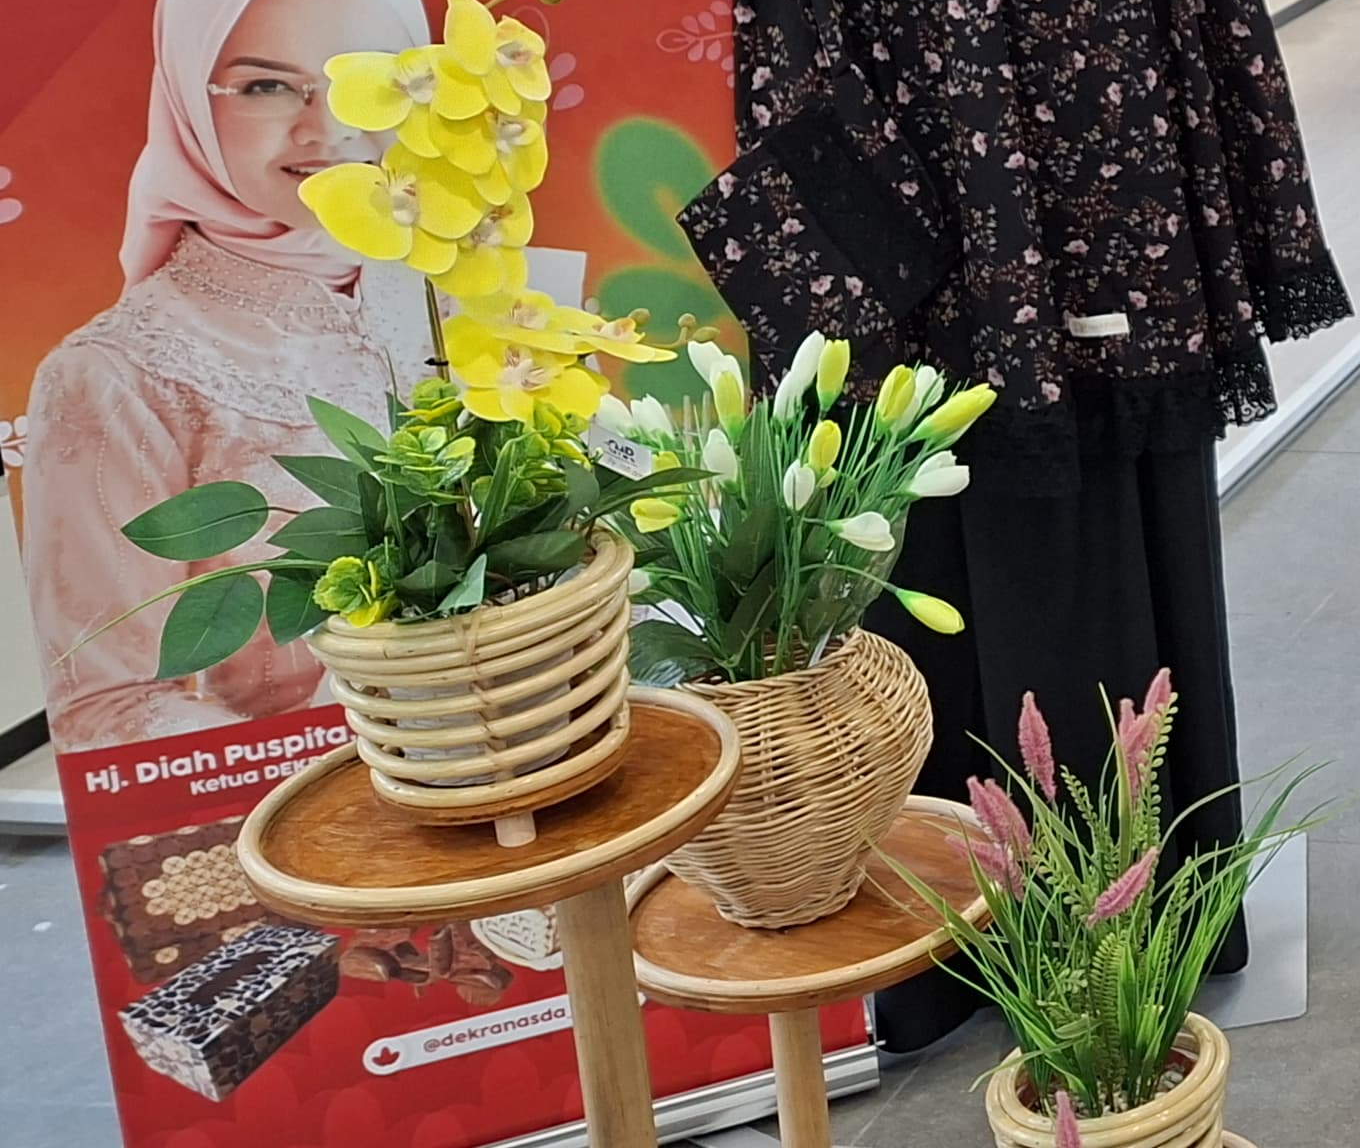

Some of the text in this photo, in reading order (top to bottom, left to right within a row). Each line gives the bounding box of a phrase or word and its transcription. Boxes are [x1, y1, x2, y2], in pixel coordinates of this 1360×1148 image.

[84, 764, 129, 793] Hj.
[135, 749, 217, 784] Diah
[189, 755, 322, 796] Ketua DEK
